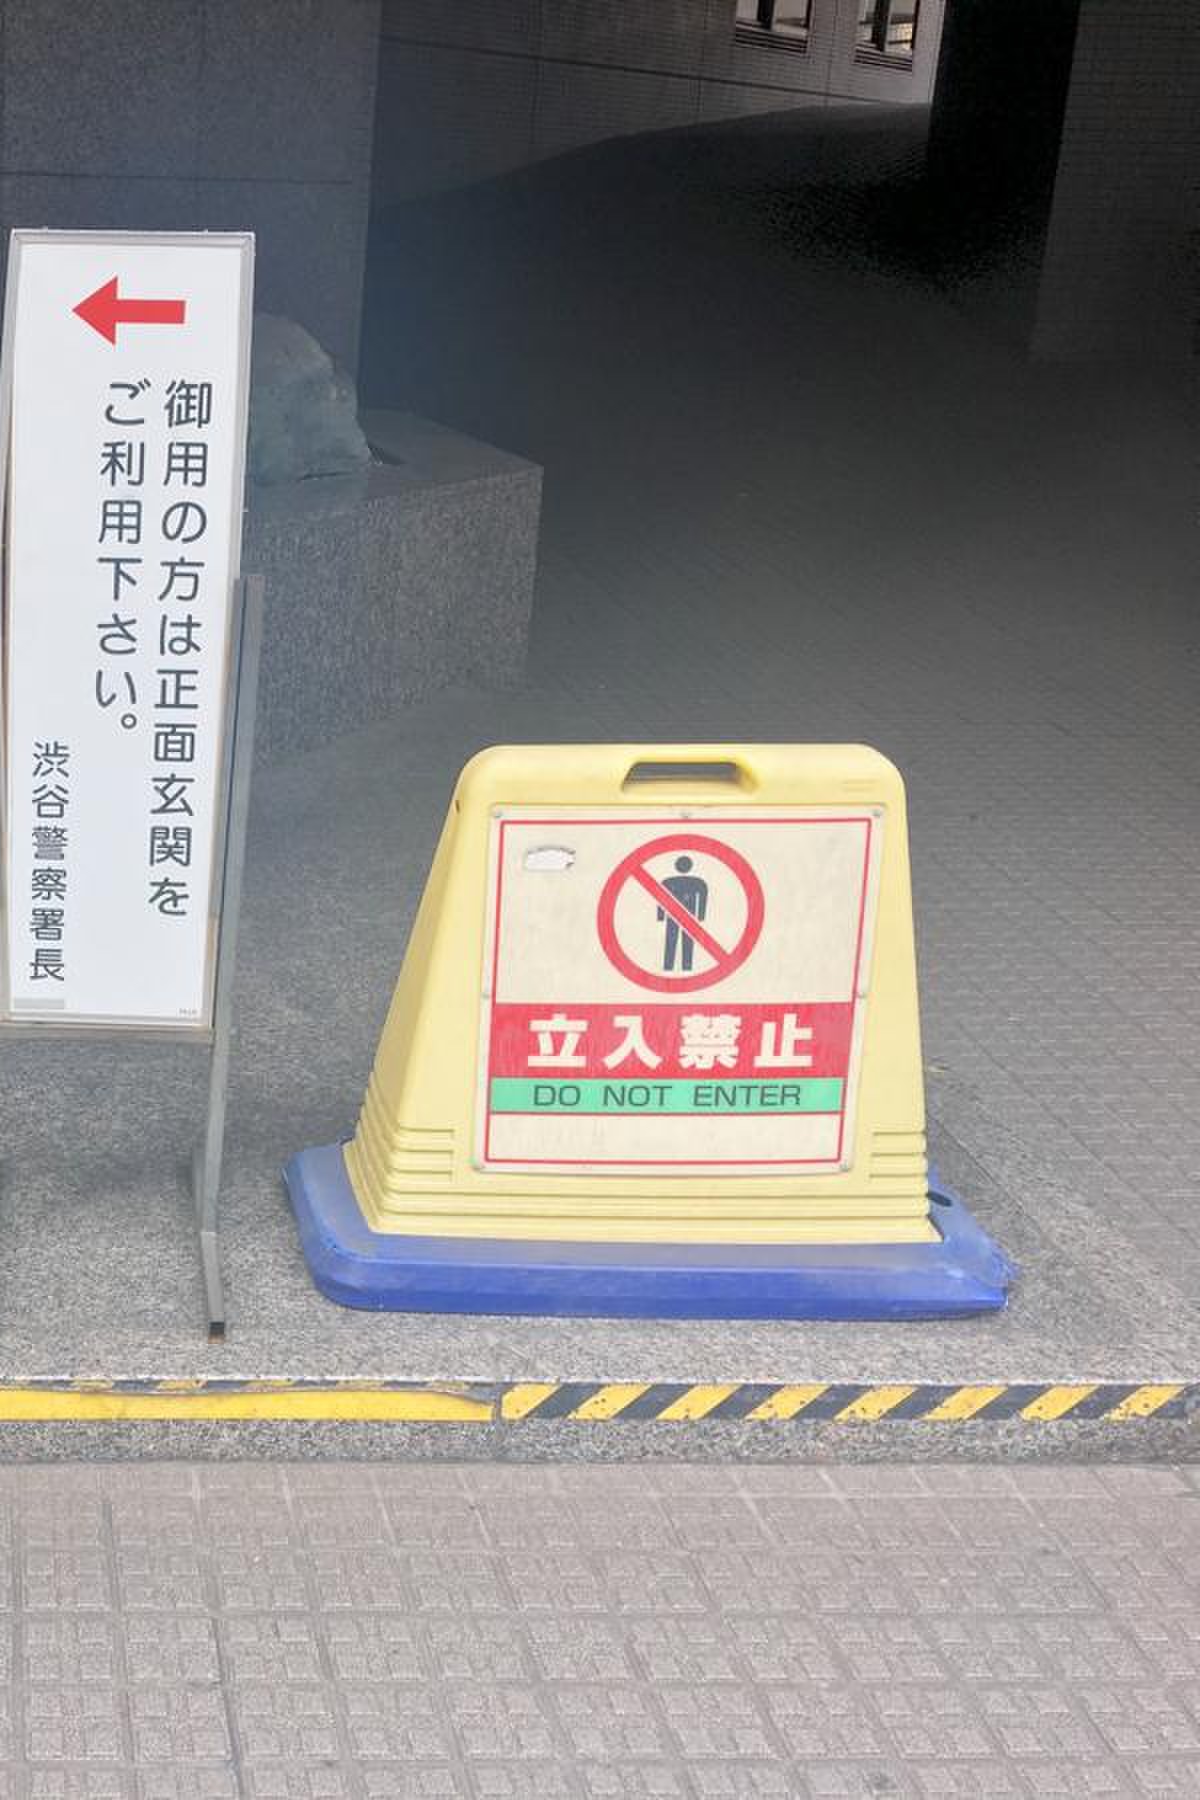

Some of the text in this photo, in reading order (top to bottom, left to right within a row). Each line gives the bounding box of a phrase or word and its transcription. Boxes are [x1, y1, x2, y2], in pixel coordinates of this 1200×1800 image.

[95, 378, 151, 731] ご利用下さい。
[148, 380, 213, 916] 御用の方は正面玄関を
[29, 741, 70, 981] 渋谷警察署長
[527, 1012, 813, 1070] 立入禁止
[533, 1083, 801, 1108] DO NOT ENTER
